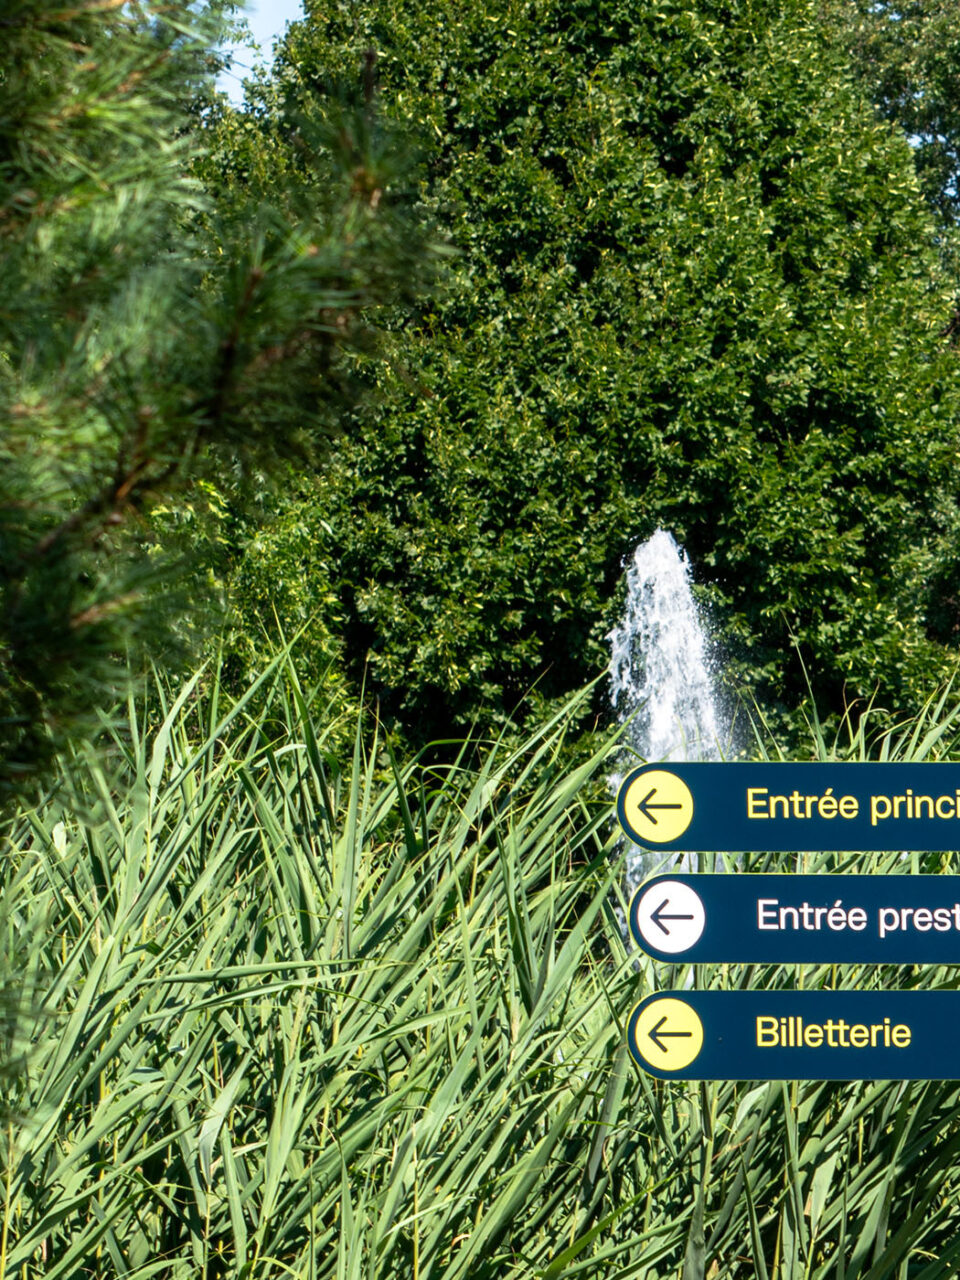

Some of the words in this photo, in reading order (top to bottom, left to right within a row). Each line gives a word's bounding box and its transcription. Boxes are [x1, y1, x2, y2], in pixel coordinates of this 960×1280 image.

[746, 787, 859, 820] Entrée
[757, 898, 868, 931] Entrée
[755, 1015, 912, 1048] Billetterie
